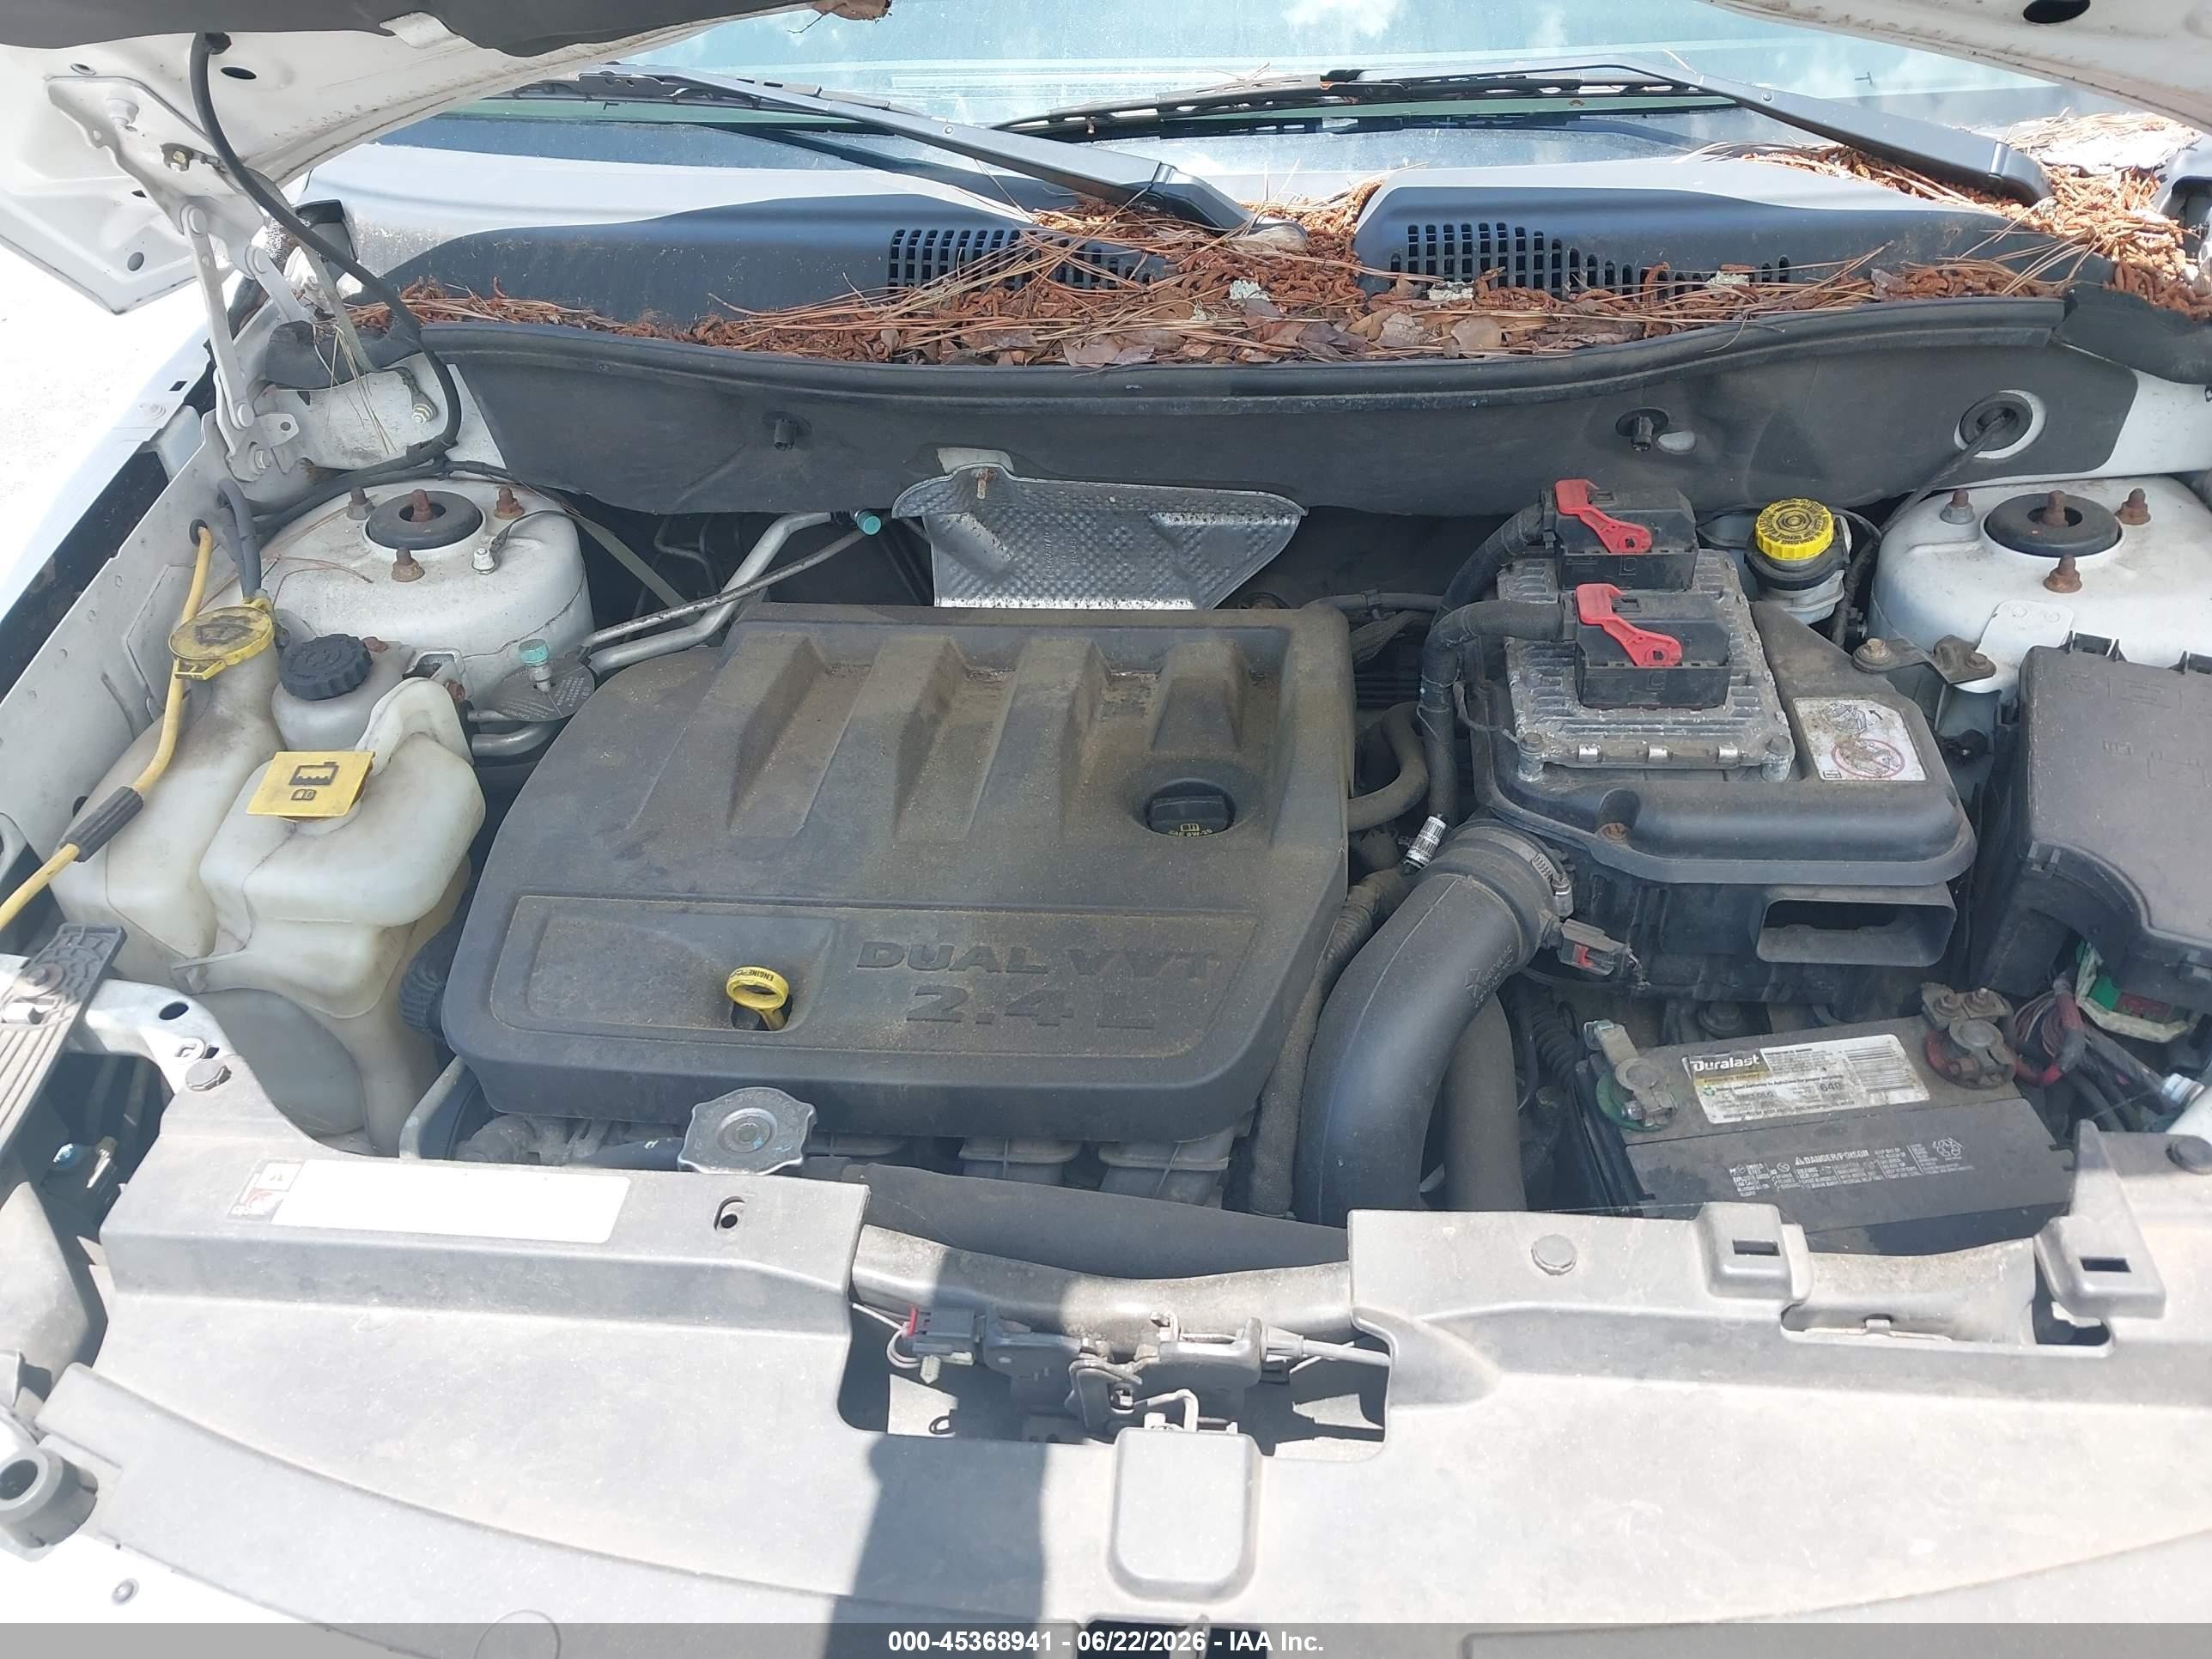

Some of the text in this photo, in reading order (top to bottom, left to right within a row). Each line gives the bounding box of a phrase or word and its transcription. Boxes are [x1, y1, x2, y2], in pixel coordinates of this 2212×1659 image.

[857, 941, 1049, 975] DUAL
[1690, 1054, 1760, 1072] Duralast
[1820, 1082, 1842, 1091] 640
